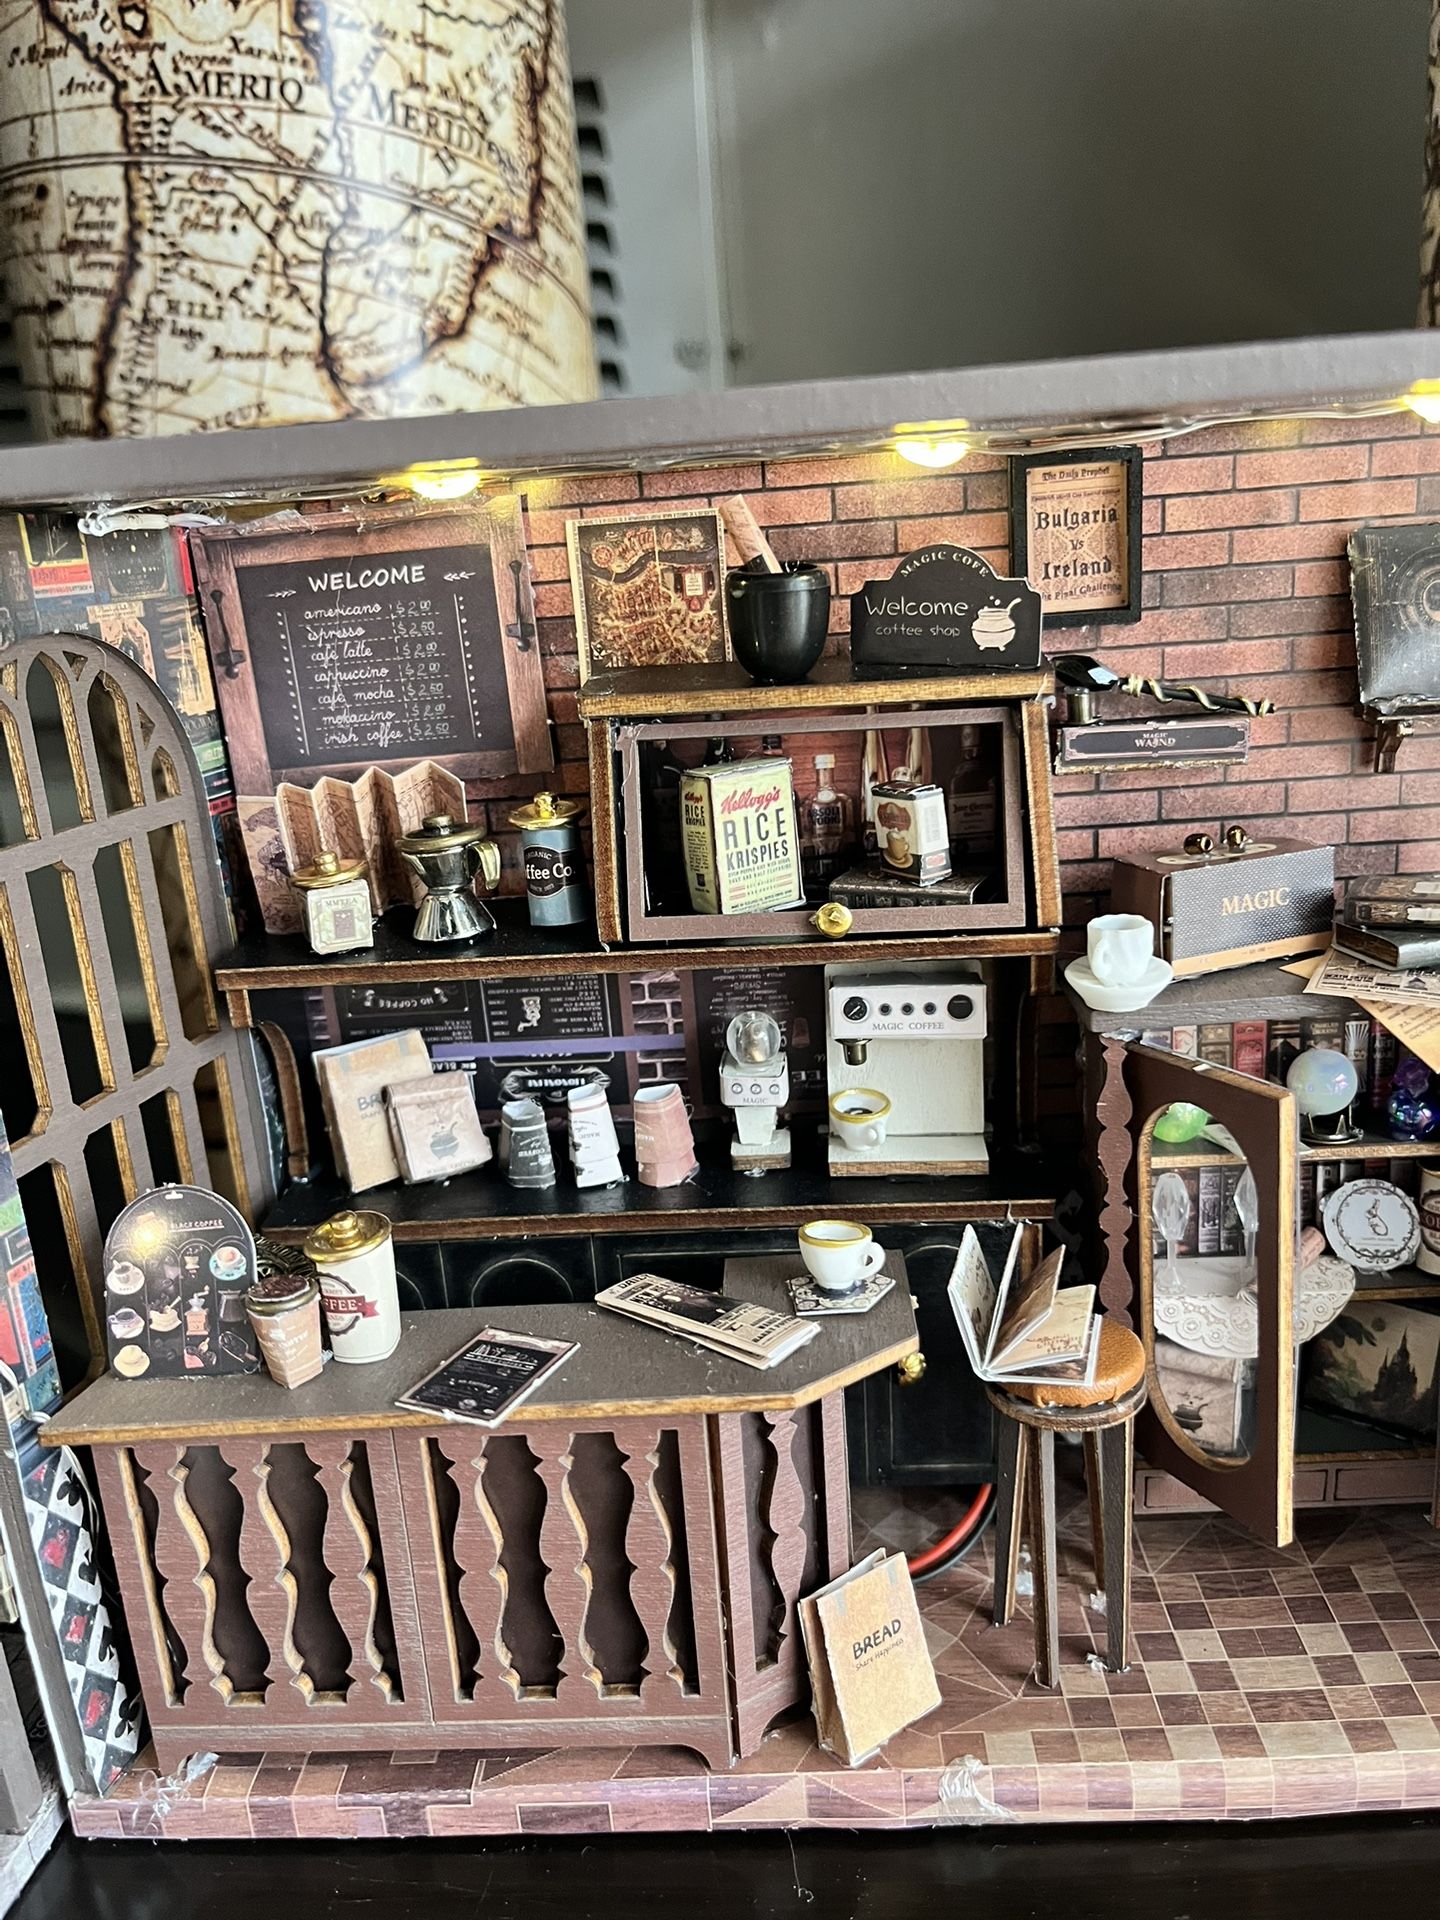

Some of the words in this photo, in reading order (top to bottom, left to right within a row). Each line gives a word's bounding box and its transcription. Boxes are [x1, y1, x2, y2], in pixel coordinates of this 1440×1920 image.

[1035, 506, 1119, 531] Bulgaria
[900, 551, 948, 578] MAGIC
[952, 551, 989, 578] COFE
[1042, 556, 1112, 581] Ireland
[308, 565, 426, 592] WELCOME
[304, 602, 382, 620] americano
[864, 595, 969, 617] Welcome
[74, 623, 88, 631] THE
[929, 624, 961, 638] shop
[343, 640, 373, 660] latte
[314, 666, 389, 689] cappuccino
[353, 684, 395, 700] mocha
[324, 728, 359, 746] irish
[366, 722, 403, 748] coffee
[685, 804, 704, 818] RICE
[721, 786, 781, 815] Kellogg's
[722, 807, 787, 850] RICE
[726, 839, 789, 871] KRISPIES
[1221, 887, 1289, 916] MAGIC
[872, 1022, 904, 1031] MAGIC
[908, 1021, 945, 1030] COFFEE
[853, 1618, 902, 1660] BREAD
